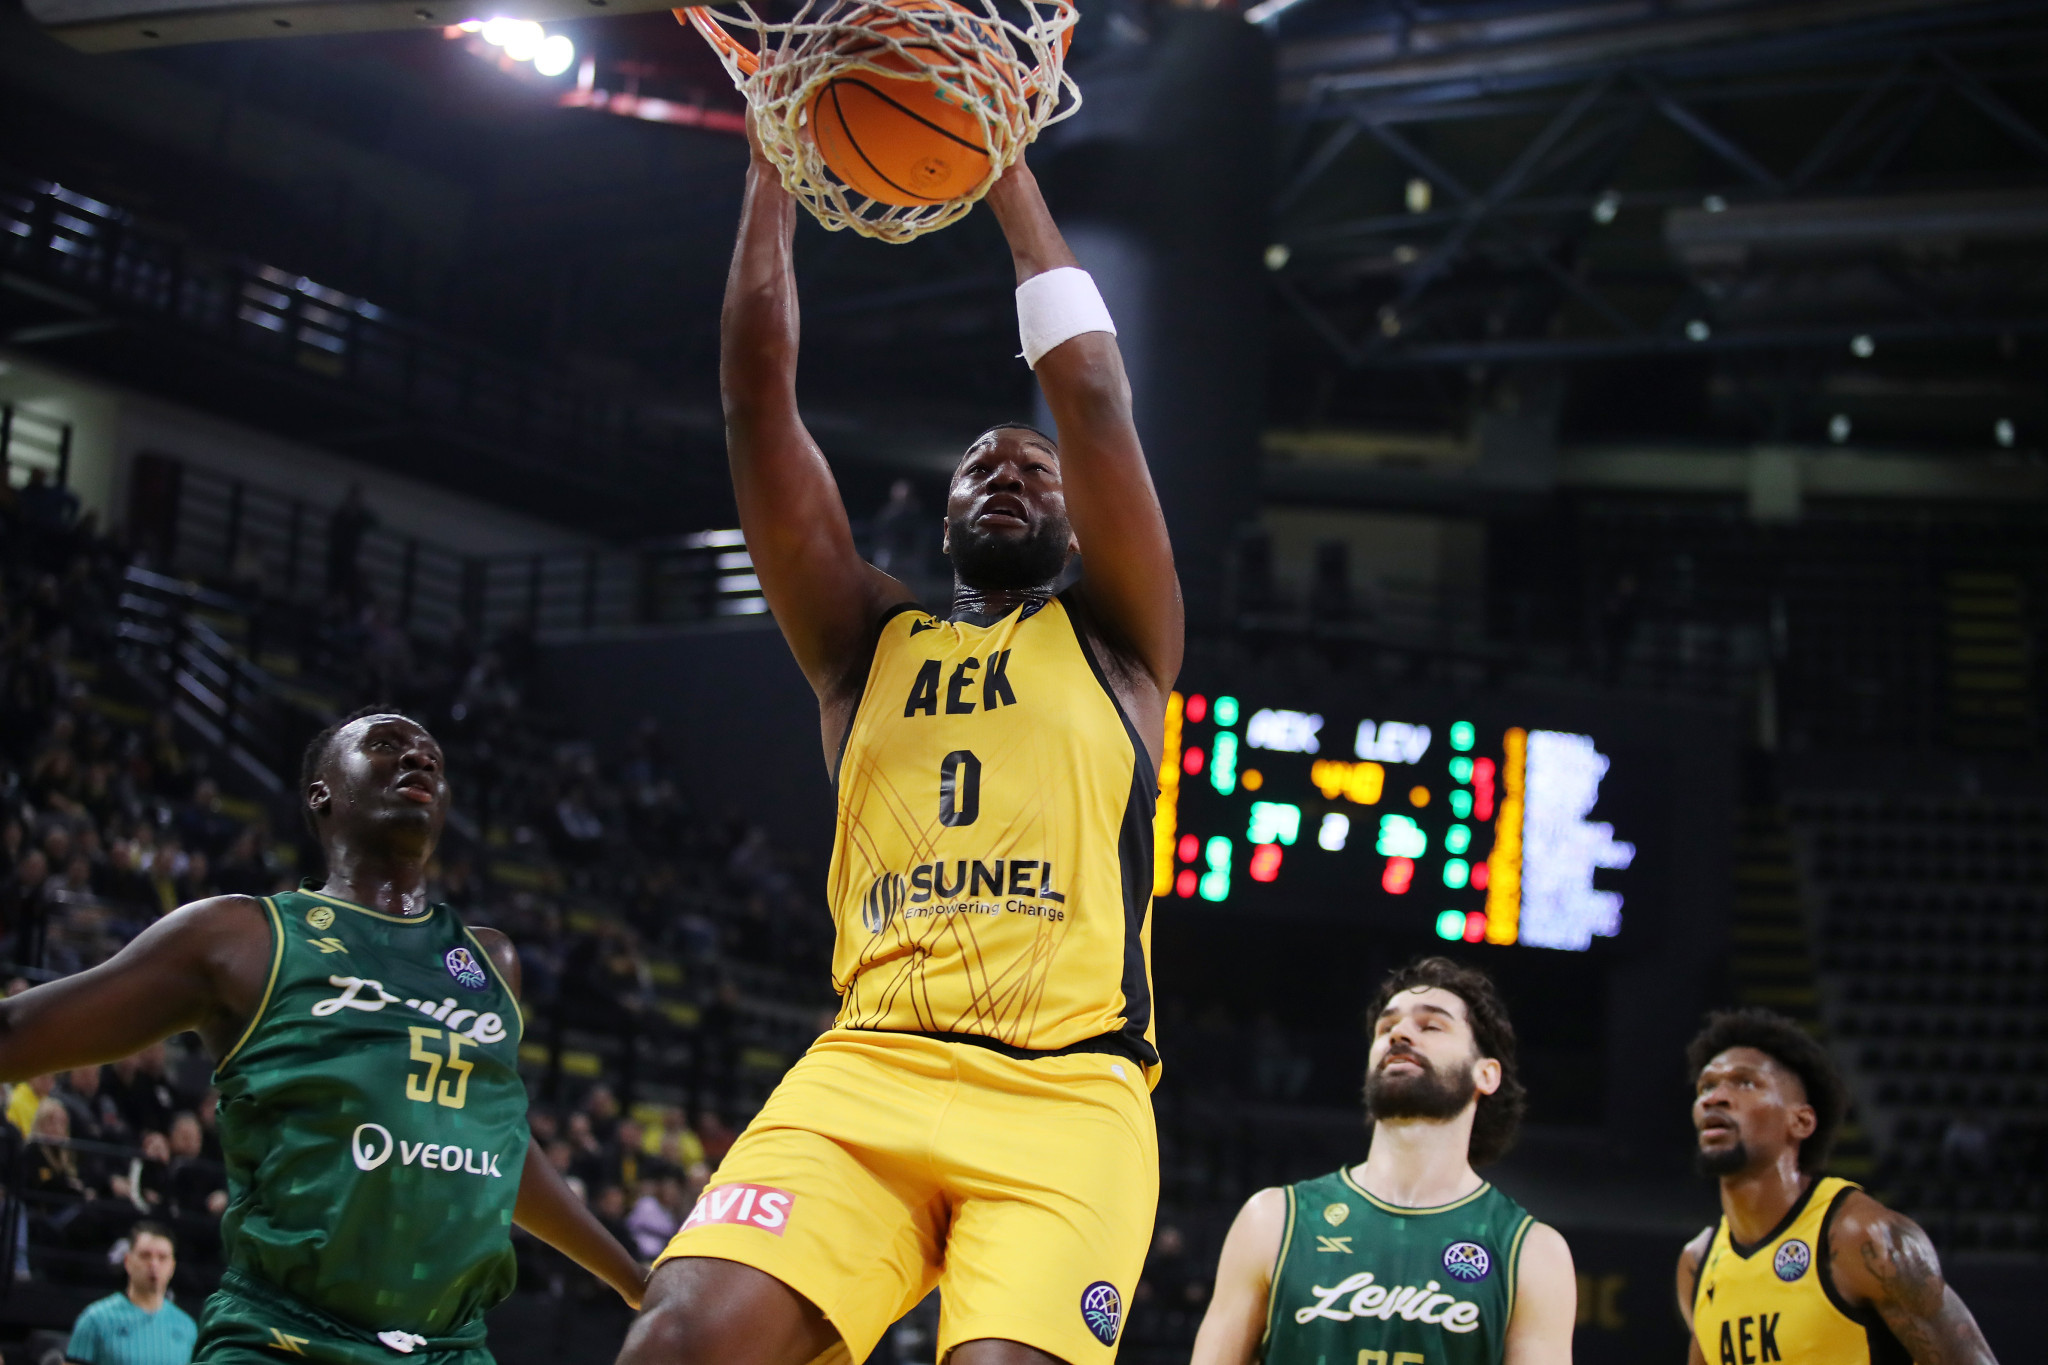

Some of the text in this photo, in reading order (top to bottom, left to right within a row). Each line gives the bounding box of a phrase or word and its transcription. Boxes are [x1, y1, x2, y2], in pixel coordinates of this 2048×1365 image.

[903, 648, 1018, 719] AEK
[938, 749, 982, 827] 0
[910, 859, 1065, 904] SUNEL
[905, 899, 1065, 922] Empowering Change
[406, 1025, 480, 1110] 55
[680, 1187, 790, 1232] AVIS
[1295, 1272, 1480, 1333] Levice
[1719, 1312, 1782, 1365] AEK
